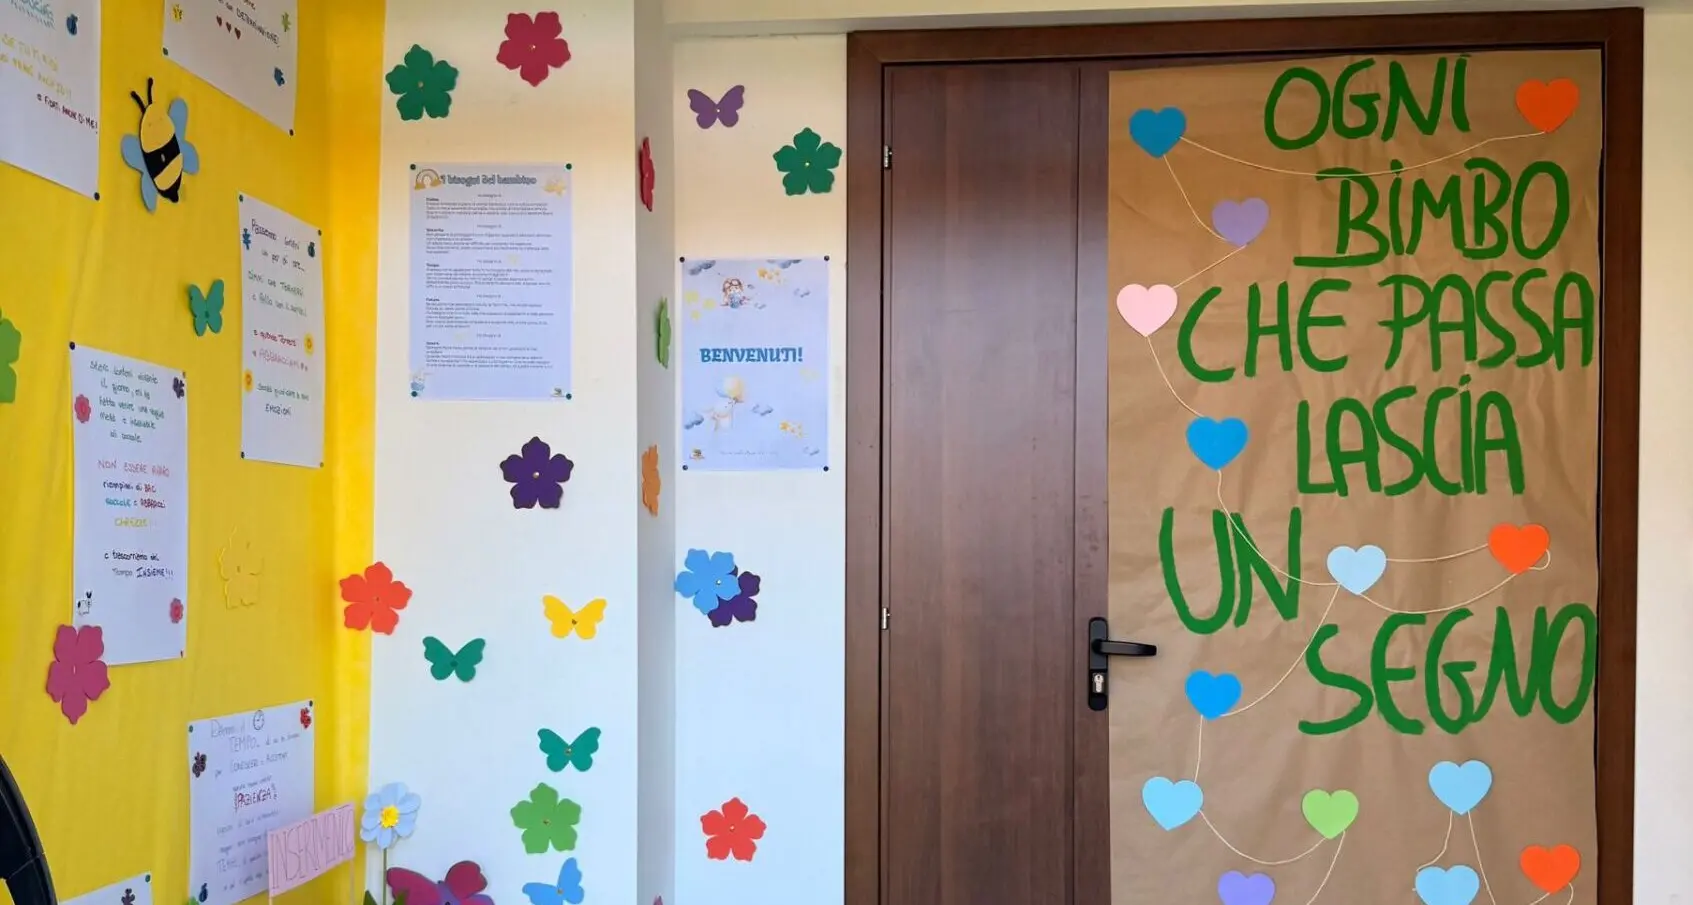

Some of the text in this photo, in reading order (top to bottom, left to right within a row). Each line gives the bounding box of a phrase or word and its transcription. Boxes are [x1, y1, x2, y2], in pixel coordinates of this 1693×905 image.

[699, 347, 804, 363] BENVENUTI!
[1177, 268, 1595, 383] CHE PASSA
[1297, 374, 1525, 497] LASCIA
[1159, 506, 1302, 635] UN
[1298, 602, 1598, 735] SEGNO
[270, 804, 355, 891] INSERIMENTO
